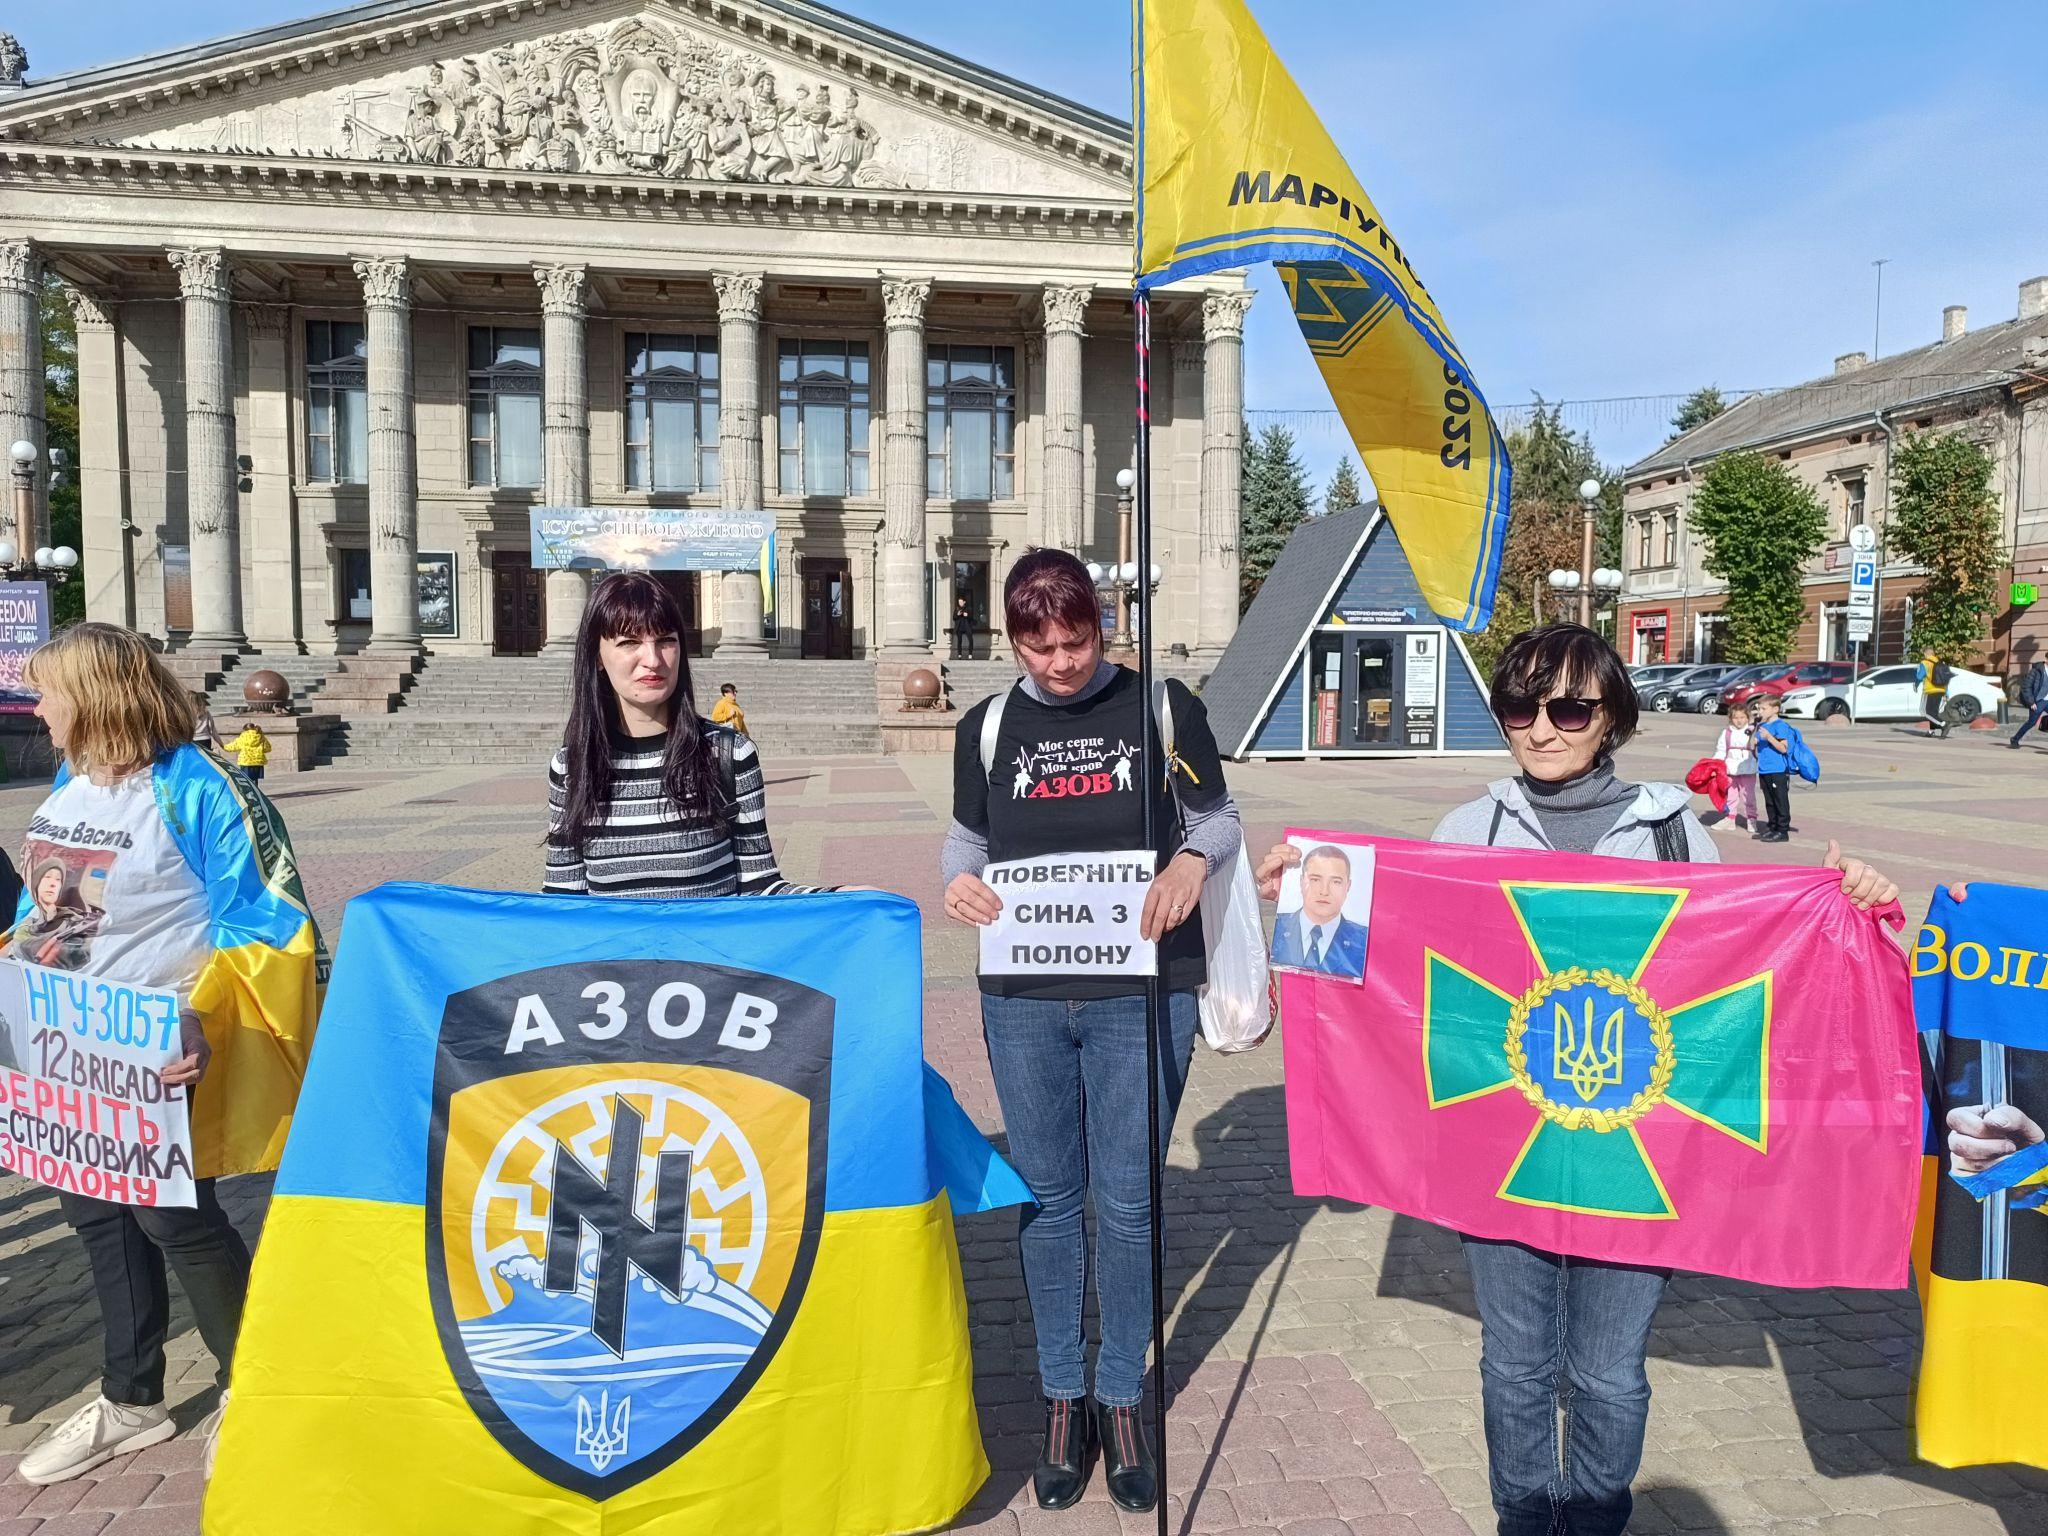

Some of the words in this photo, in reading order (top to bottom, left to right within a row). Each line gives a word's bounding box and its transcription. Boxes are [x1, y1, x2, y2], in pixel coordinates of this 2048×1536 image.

[618, 510, 709, 519] ТЕАТРАЛЬНОГО
[541, 519, 585, 535] ІСУС
[1037, 740, 1064, 753] Моє
[1066, 737, 1104, 751] серце
[1071, 761, 1103, 774] кров
[1027, 772, 1113, 799] АЗОВ
[70, 821, 134, 849] Василь
[991, 863, 1153, 884] ПОВЕРНІТЬ
[1014, 904, 1095, 924] СИНА
[1111, 904, 1128, 924] З
[1011, 945, 1133, 965] ПОЛОНУ
[504, 980, 779, 1055] АЗОВ
[31, 1028, 69, 1082] 12
[71, 1048, 184, 1104] BRIGADE
